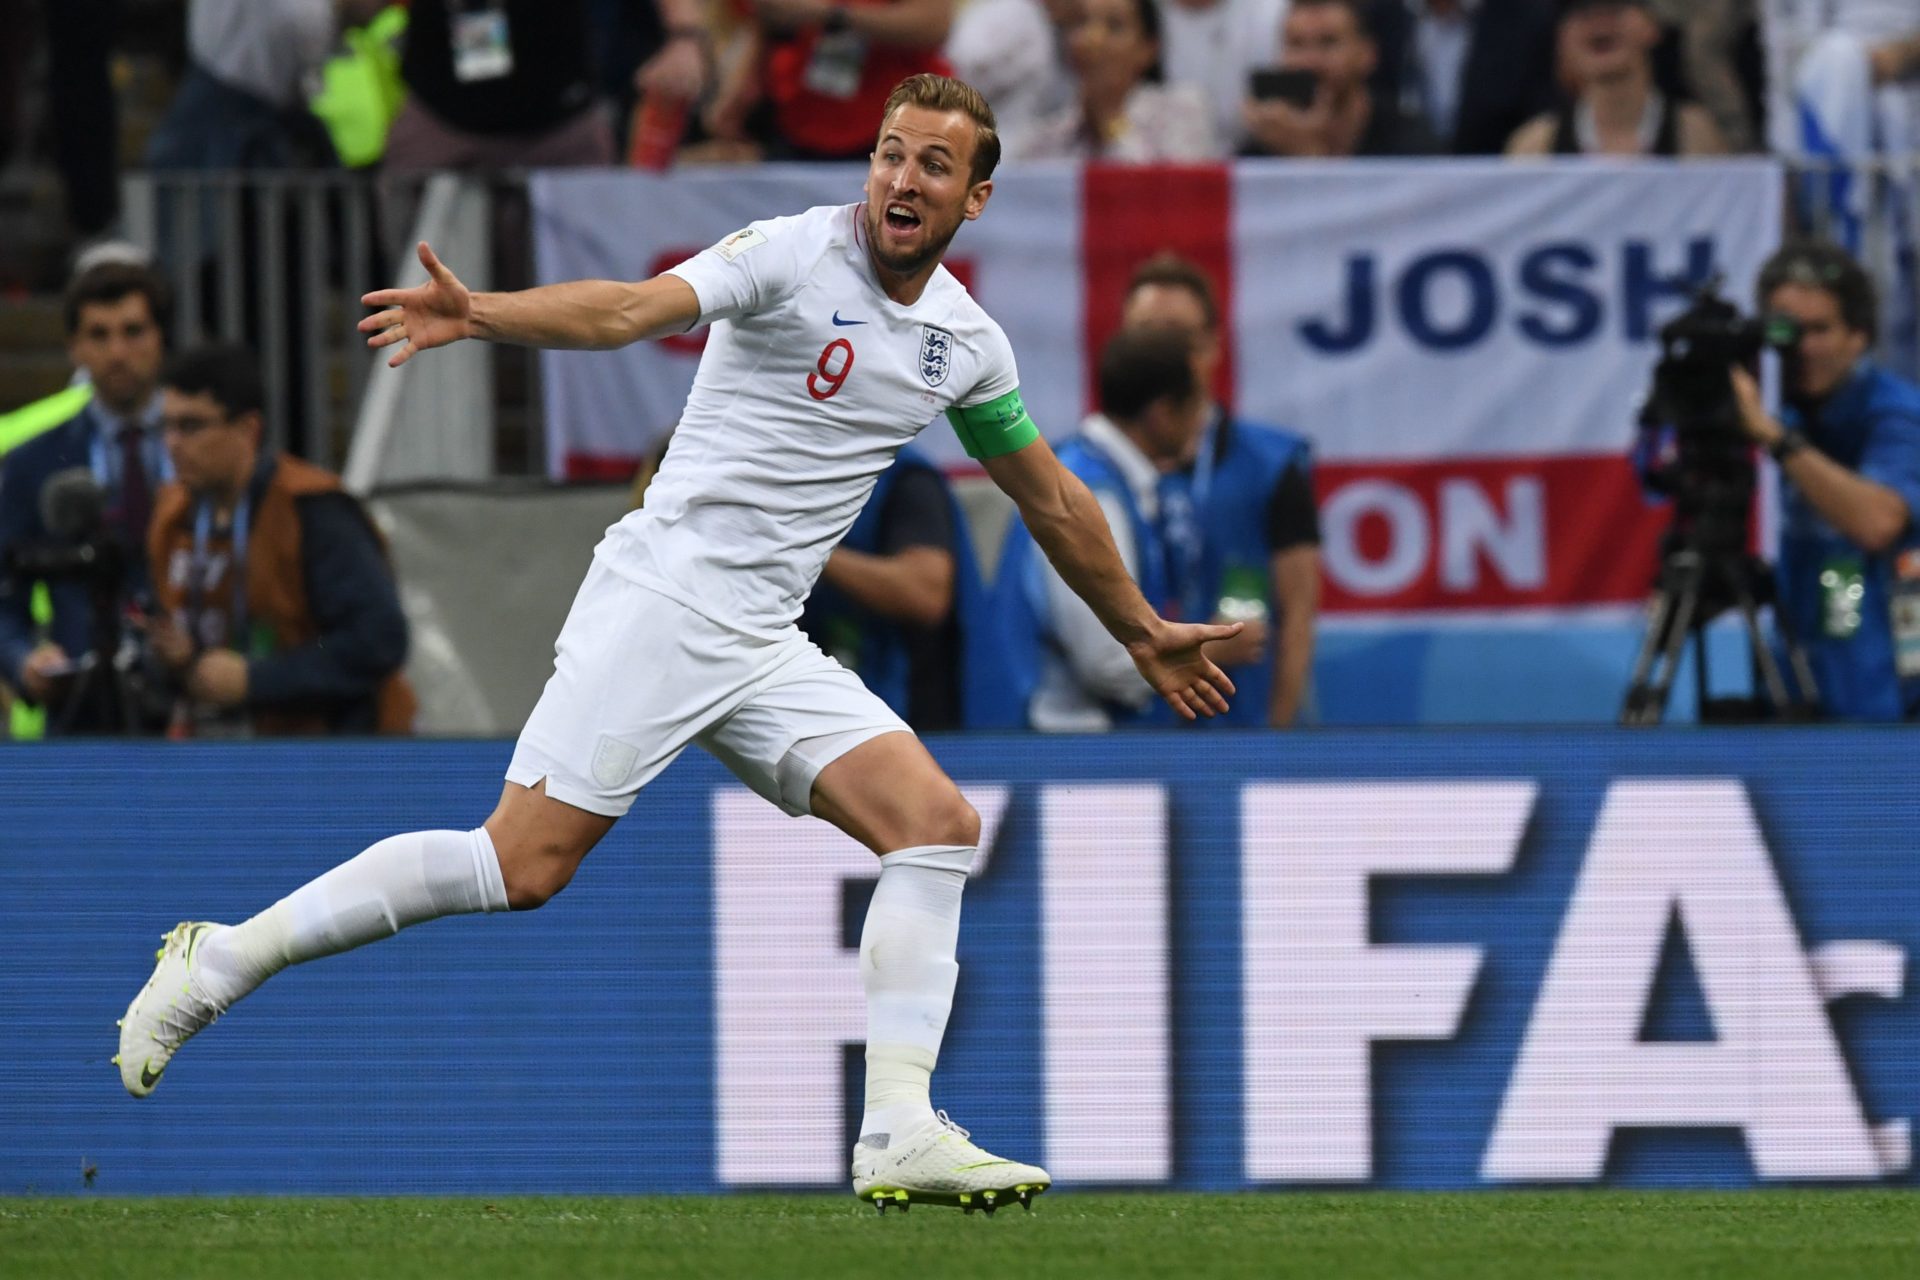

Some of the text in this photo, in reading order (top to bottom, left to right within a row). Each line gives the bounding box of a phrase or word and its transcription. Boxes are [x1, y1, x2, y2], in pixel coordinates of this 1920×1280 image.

[1297, 235, 1716, 357] JOSH
[806, 337, 855, 401] 9
[1319, 475, 1546, 596] ON
[712, 778, 1886, 1185] FIFA
